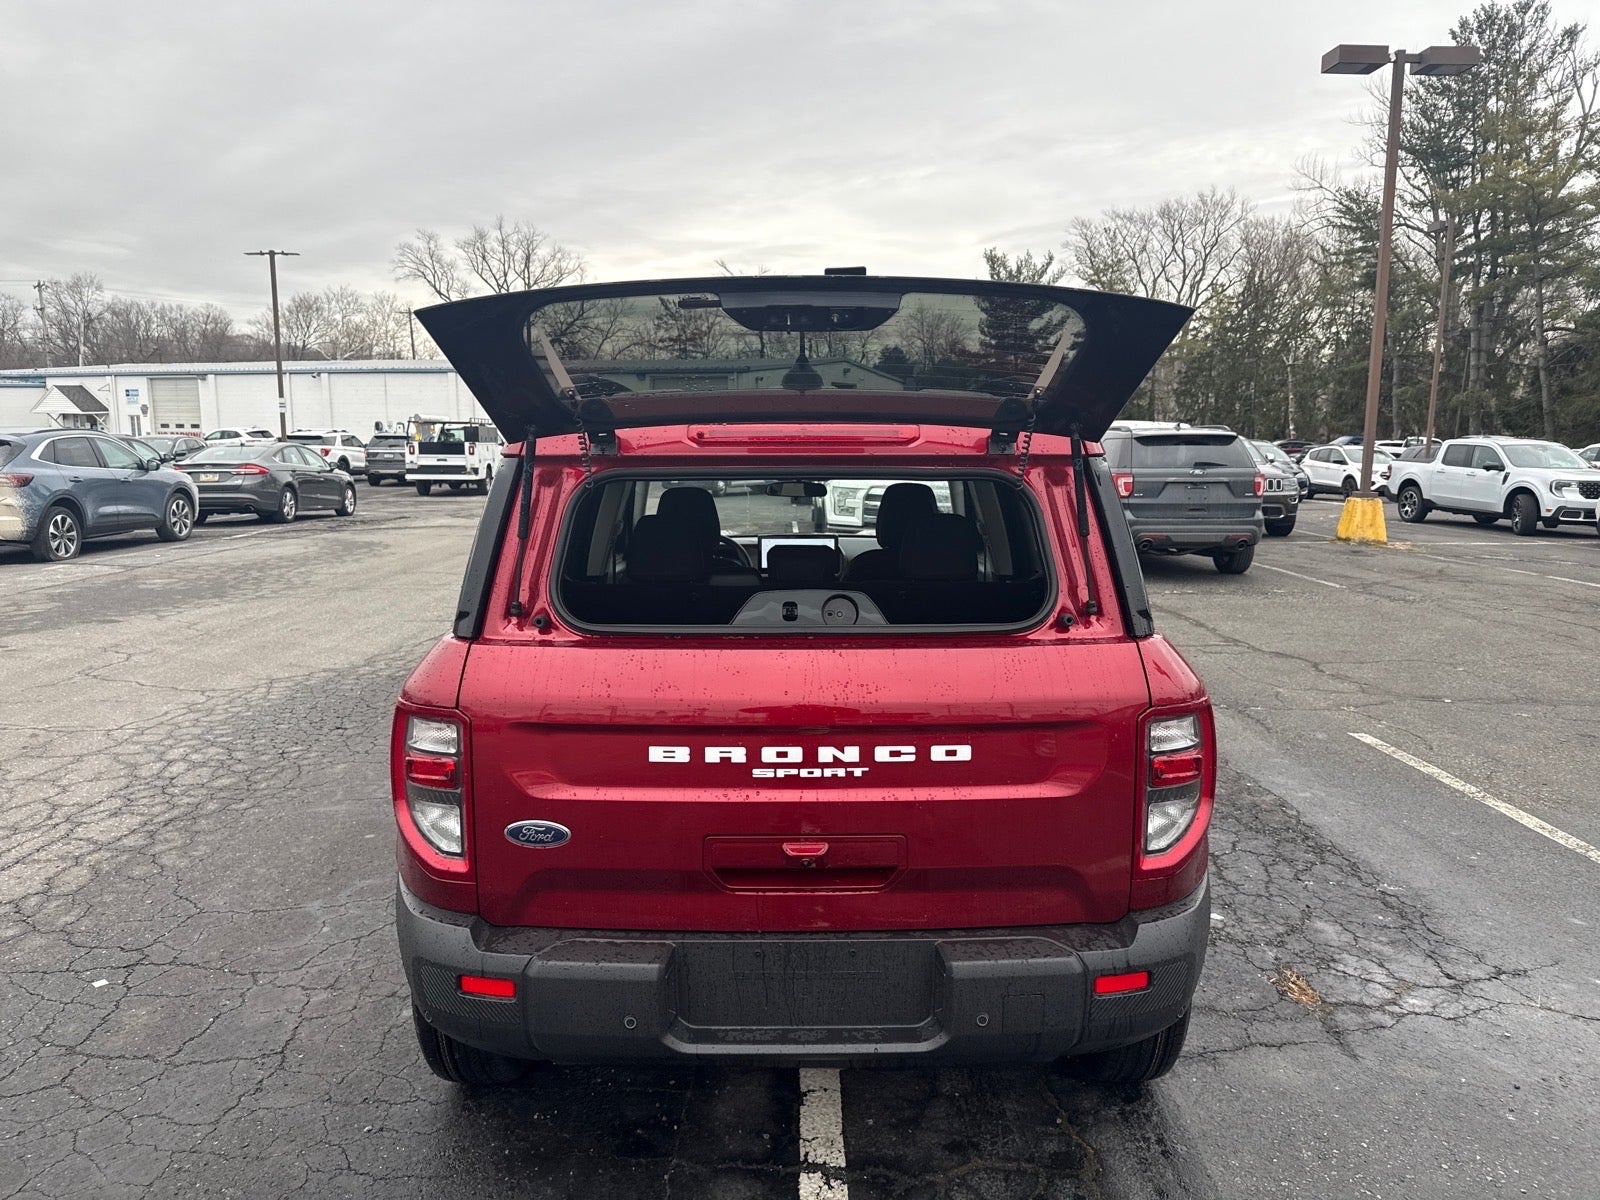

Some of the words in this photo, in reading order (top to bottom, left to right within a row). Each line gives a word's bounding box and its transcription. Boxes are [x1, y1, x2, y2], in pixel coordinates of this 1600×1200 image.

[648, 745, 972, 763] BRONCO
[752, 767, 870, 778] SPORT
[518, 825, 556, 843] Ford
